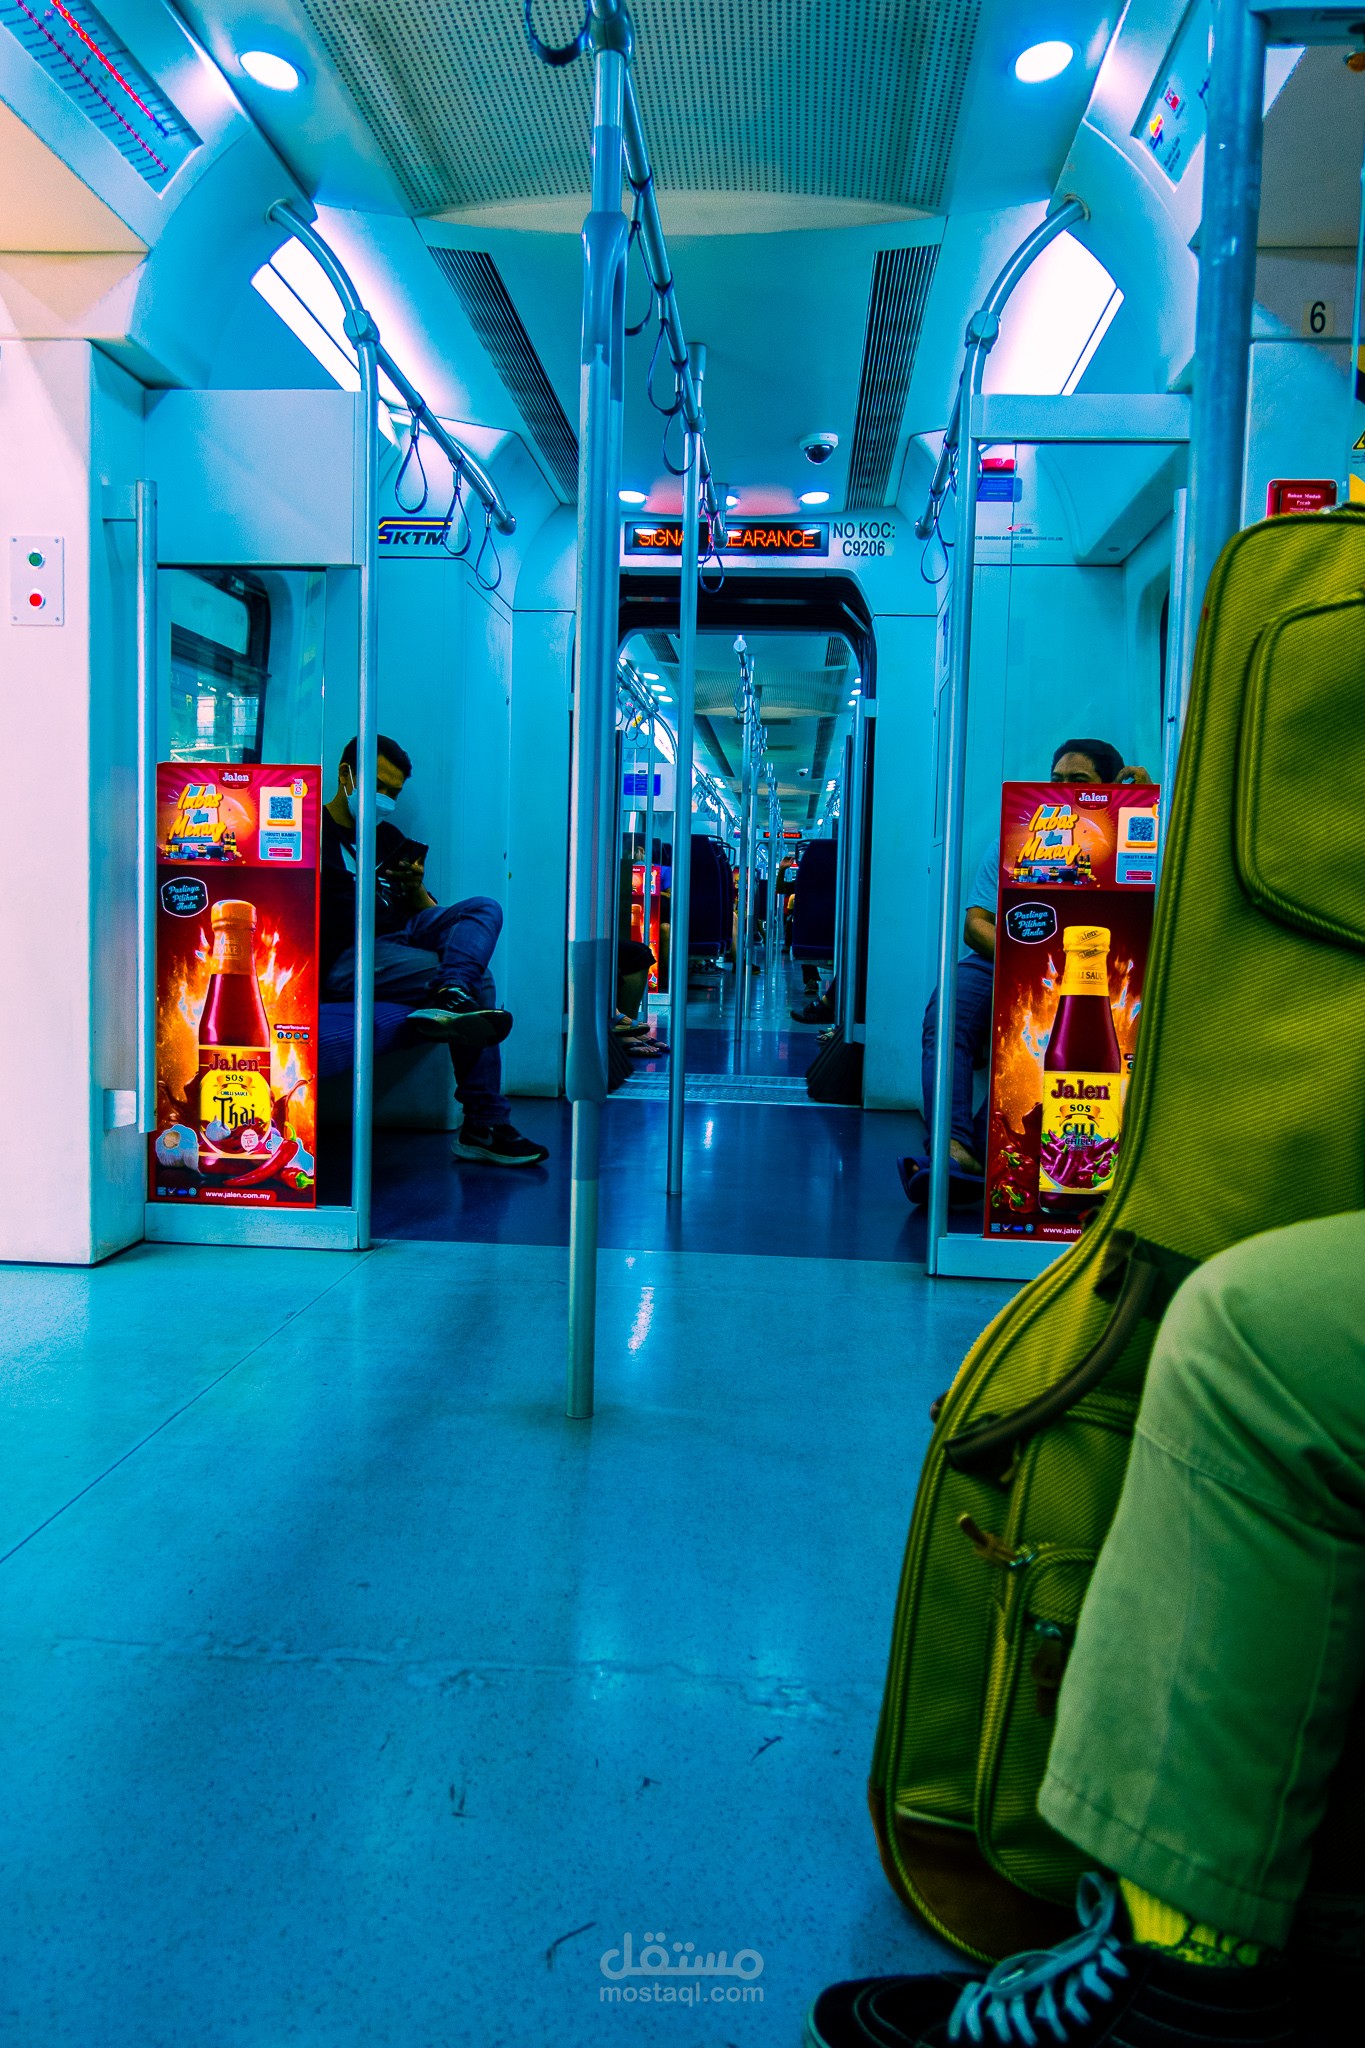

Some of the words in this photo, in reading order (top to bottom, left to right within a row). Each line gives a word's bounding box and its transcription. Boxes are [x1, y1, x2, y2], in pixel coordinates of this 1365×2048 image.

[1310, 301, 1326, 334] 6
[833, 522, 855, 538] NO
[858, 523, 895, 538] KOC:
[393, 531, 449, 545] KTM
[842, 540, 885, 557] C9206
[222, 772, 249, 781] Jalen
[177, 785, 224, 809] Imbas
[1079, 792, 1108, 802] Jalen
[1028, 804, 1079, 832] Imbas
[169, 816, 228, 843] Menang
[1017, 837, 1083, 866] Menang
[172, 893, 198, 902] Pilihan
[176, 902, 197, 911] Anda
[1018, 920, 1046, 928] Pilihan
[1021, 928, 1044, 937] Anda
[209, 1053, 260, 1072] Jalen
[225, 1074, 244, 1082] SOS
[1051, 1079, 1110, 1100] Jalen
[213, 1096, 255, 1130] Thai
[1069, 1104, 1091, 1112] SOS
[1063, 1123, 1095, 1136] CILI
[205, 1191, 270, 1200] www.jalen.com.my
